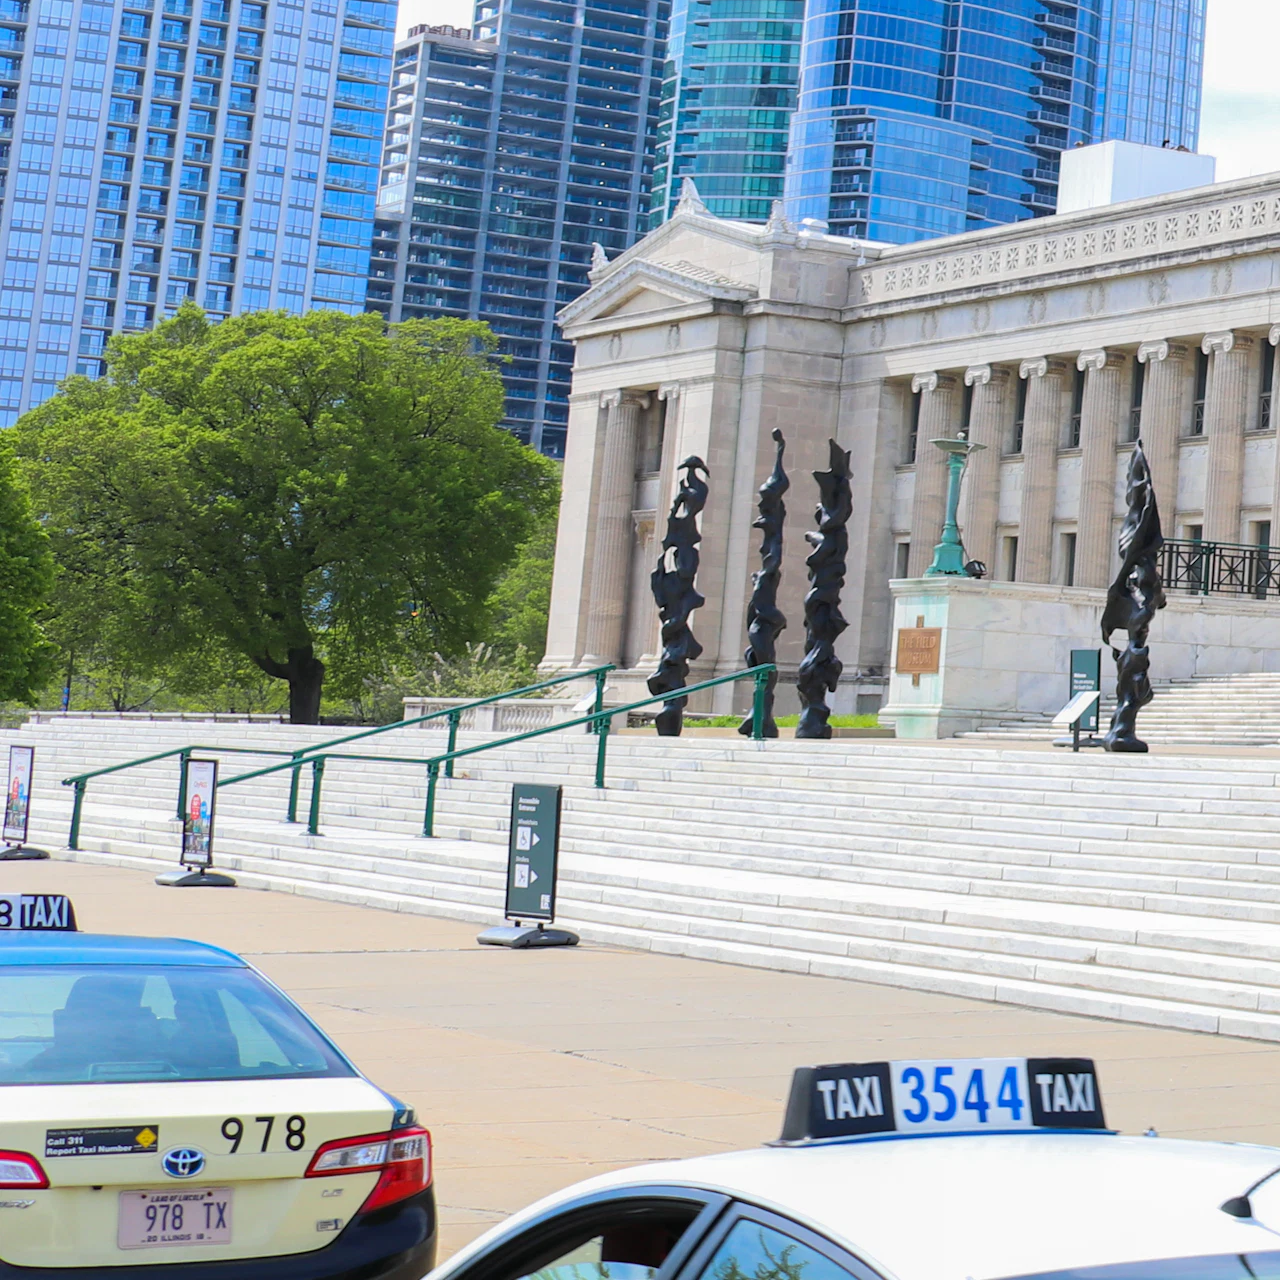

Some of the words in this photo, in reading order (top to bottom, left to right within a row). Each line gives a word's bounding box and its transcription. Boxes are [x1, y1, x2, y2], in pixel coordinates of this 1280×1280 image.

[916, 636, 936, 649] FIELD
[21, 896, 68, 927] TAXI
[817, 1075, 884, 1120] TAXI
[901, 1066, 1023, 1123] 3544
[1035, 1073, 1095, 1112] TAXI
[47, 1138, 65, 1146] Call
[67, 1136, 84, 1145] 311
[221, 1114, 306, 1154] 978
[46, 1147, 76, 1156] Report
[79, 1146, 96, 1154] Taxi
[145, 1204, 183, 1232] 978
[203, 1202, 227, 1229] TX
[161, 1233, 191, 1242] ILLINOIS
